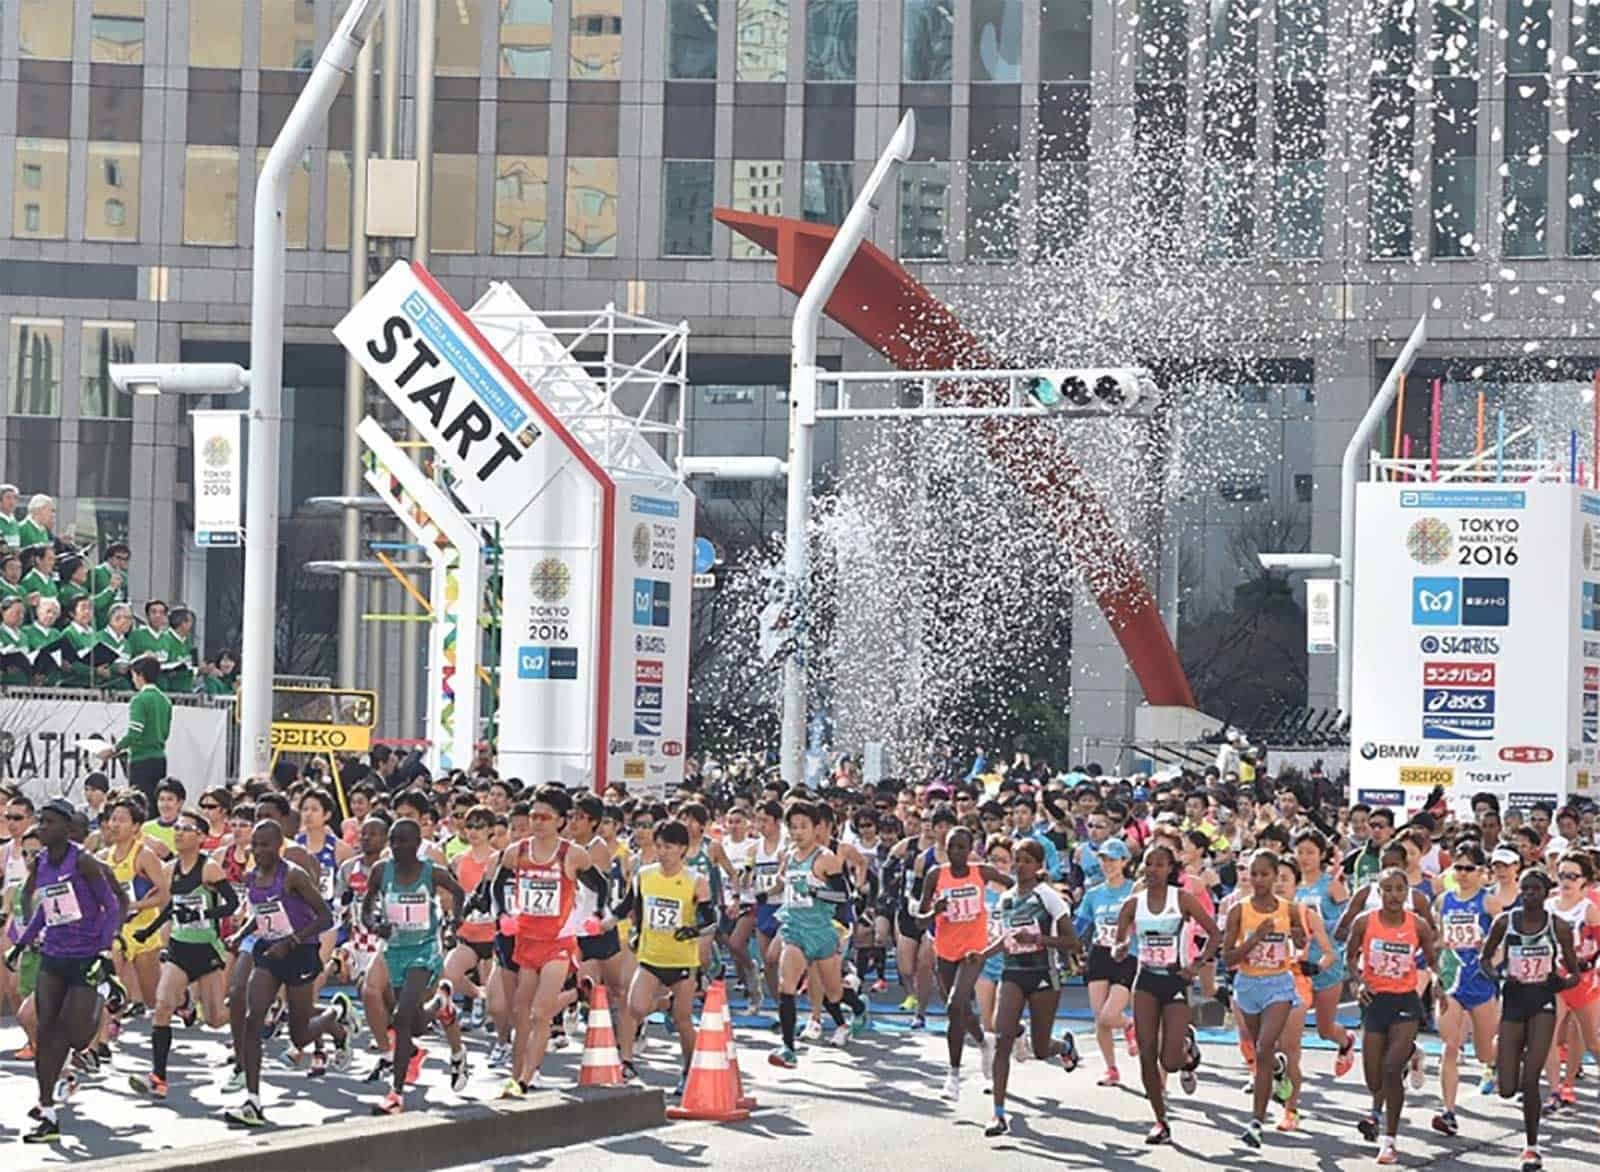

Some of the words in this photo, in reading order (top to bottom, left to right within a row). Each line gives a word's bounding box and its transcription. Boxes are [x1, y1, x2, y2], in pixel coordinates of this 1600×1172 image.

[366, 315, 523, 482] START
[1458, 518, 1519, 532] TOKYO
[1459, 535, 1518, 544] MARATHON
[652, 550, 675, 570] 2016
[1458, 545, 1518, 565] 2016
[529, 606, 570, 617] TOKYO
[529, 625, 569, 640] 2016
[271, 727, 347, 747] SEIKO
[1379, 744, 1420, 759] BMW
[1401, 768, 1452, 783] SEIKO
[525, 891, 555, 909] 127
[405, 906, 411, 922] 1
[650, 908, 678, 926] 152
[1521, 959, 1541, 976] 37
